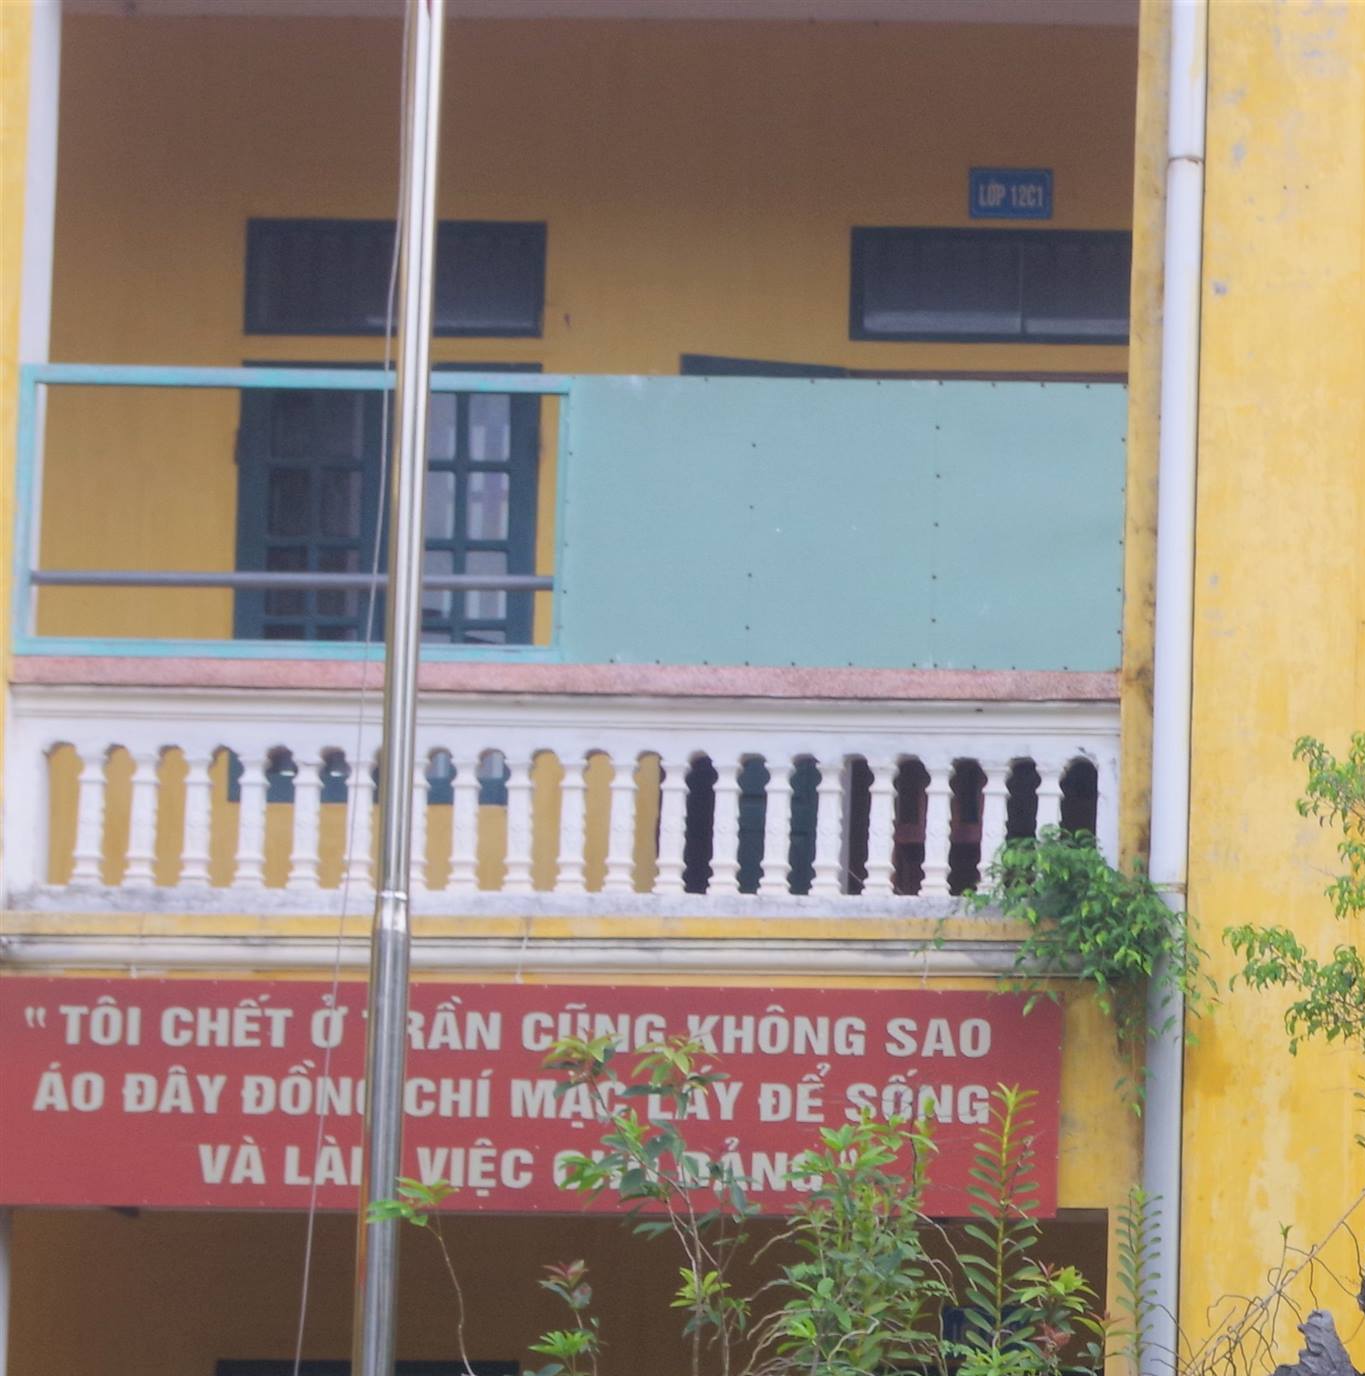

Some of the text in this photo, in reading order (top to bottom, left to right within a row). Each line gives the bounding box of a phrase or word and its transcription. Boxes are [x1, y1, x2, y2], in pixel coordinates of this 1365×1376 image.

[160, 993, 293, 1048] CHẾT
[311, 993, 349, 1049] Ở
[362, 995, 503, 1051] RẦN
[521, 1003, 667, 1053] CŨNG
[687, 1004, 867, 1057] KHÔNG
[885, 1017, 992, 1059] SAO
[33, 1062, 106, 1112] ÁO
[122, 1064, 228, 1114] ĐÂY
[404, 1069, 494, 1118] CHÍ
[647, 1065, 744, 1121] LẤY
[758, 1062, 826, 1123] ĐỂ
[844, 1068, 990, 1125] SỐNG
[199, 1135, 266, 1185] VÀ
[416, 1138, 534, 1197] VIỆC
